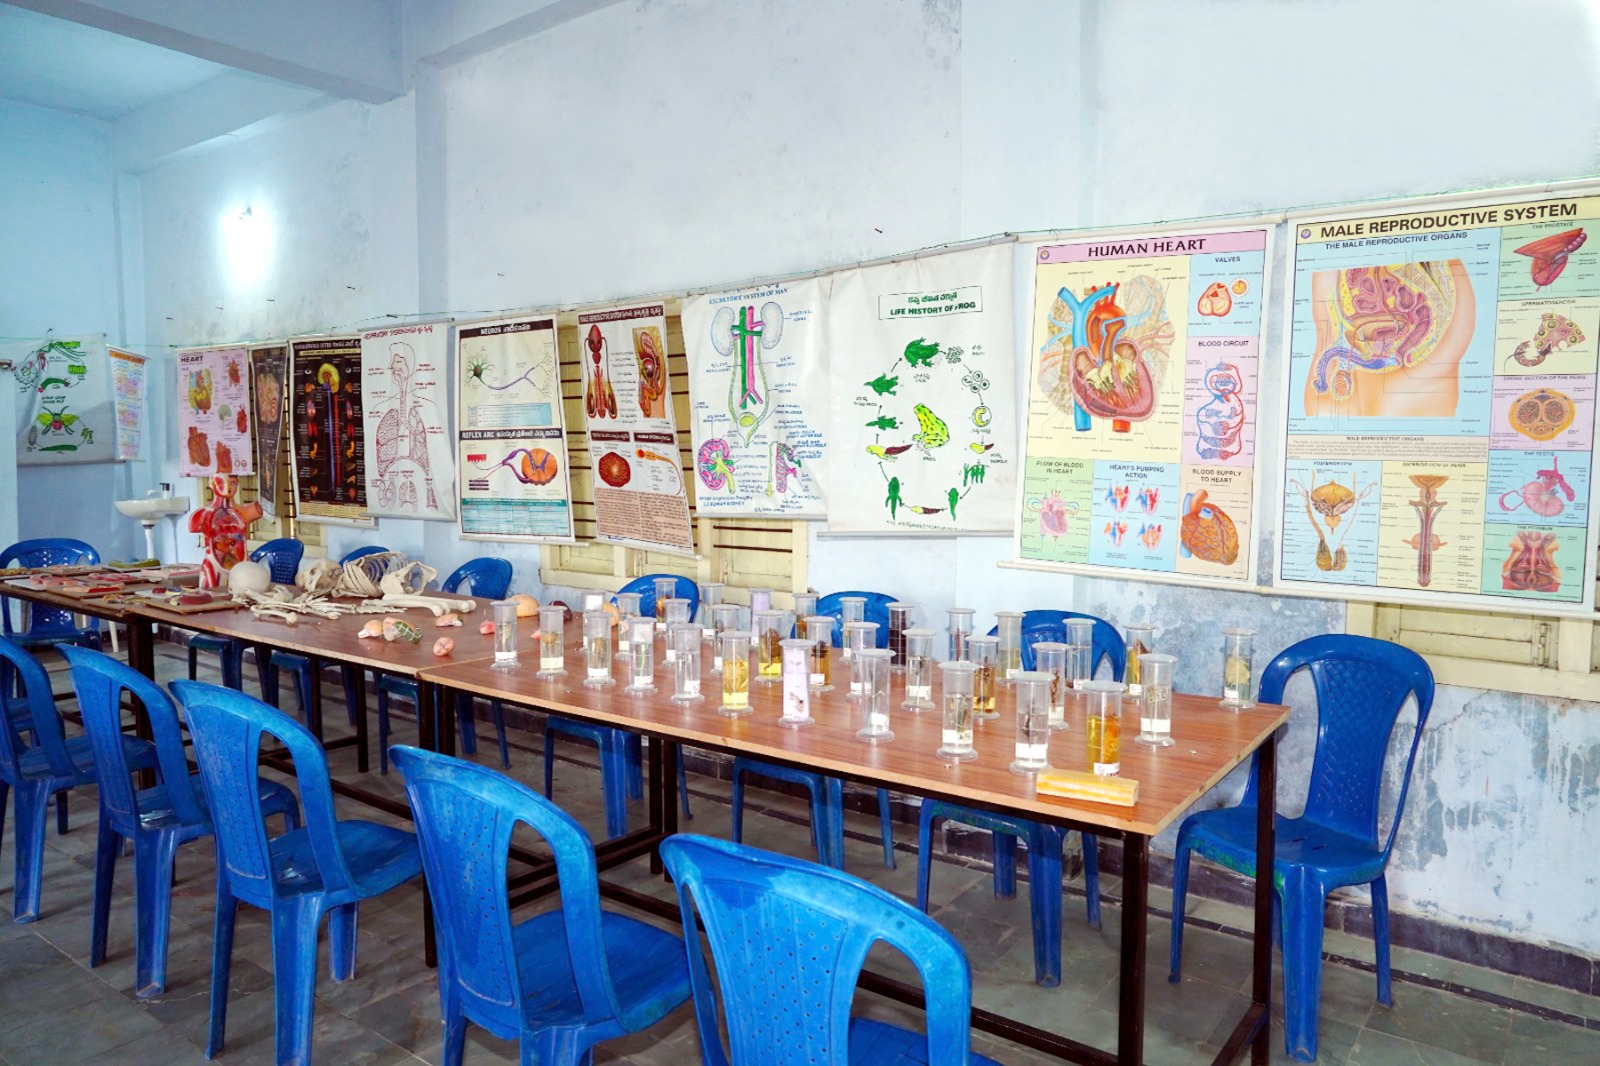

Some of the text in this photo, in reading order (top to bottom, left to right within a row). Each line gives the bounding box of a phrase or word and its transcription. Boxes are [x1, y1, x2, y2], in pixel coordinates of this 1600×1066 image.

[1321, 203, 1577, 238] MALE REPRODUCTIVE SYSTEM
[1366, 235, 1428, 246] REPRODUCTIVE
[1431, 232, 1468, 241] ORGANS
[1088, 239, 1206, 257] HUMAN HEART
[890, 308, 906, 316] LIFE
[908, 307, 942, 315] HISTORY
[1198, 340, 1222, 348] BLOOD
